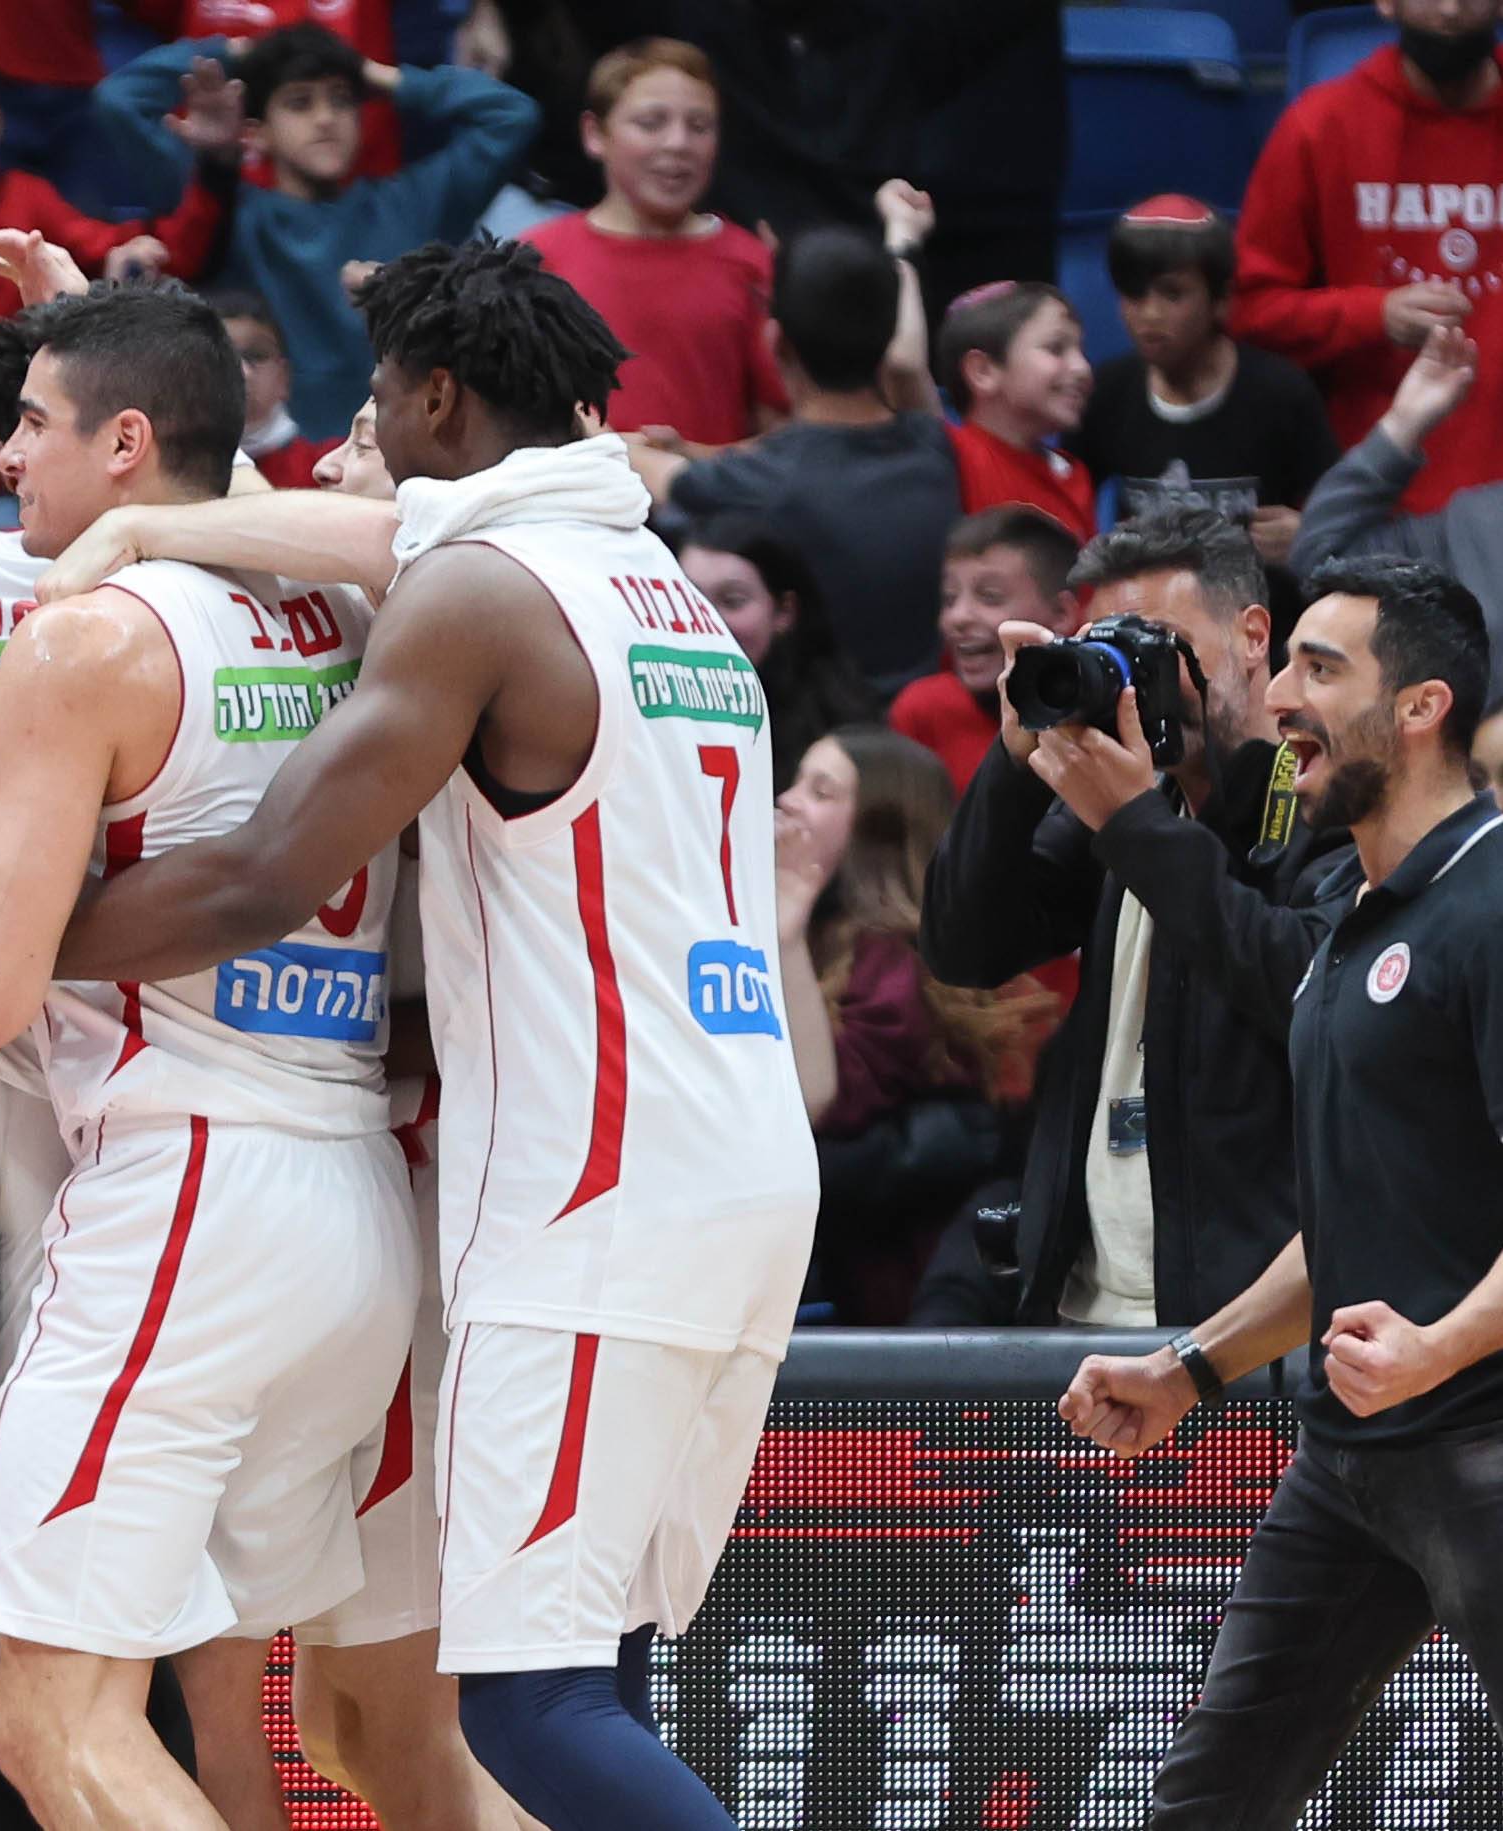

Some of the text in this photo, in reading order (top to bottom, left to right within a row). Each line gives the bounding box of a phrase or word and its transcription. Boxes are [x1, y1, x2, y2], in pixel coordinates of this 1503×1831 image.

[1354, 182, 1503, 230] HAPO
[1089, 629, 1115, 638] Nikon
[697, 744, 740, 927] 7
[231, 958, 364, 1019] הדסה
[700, 962, 769, 1013] דסה
